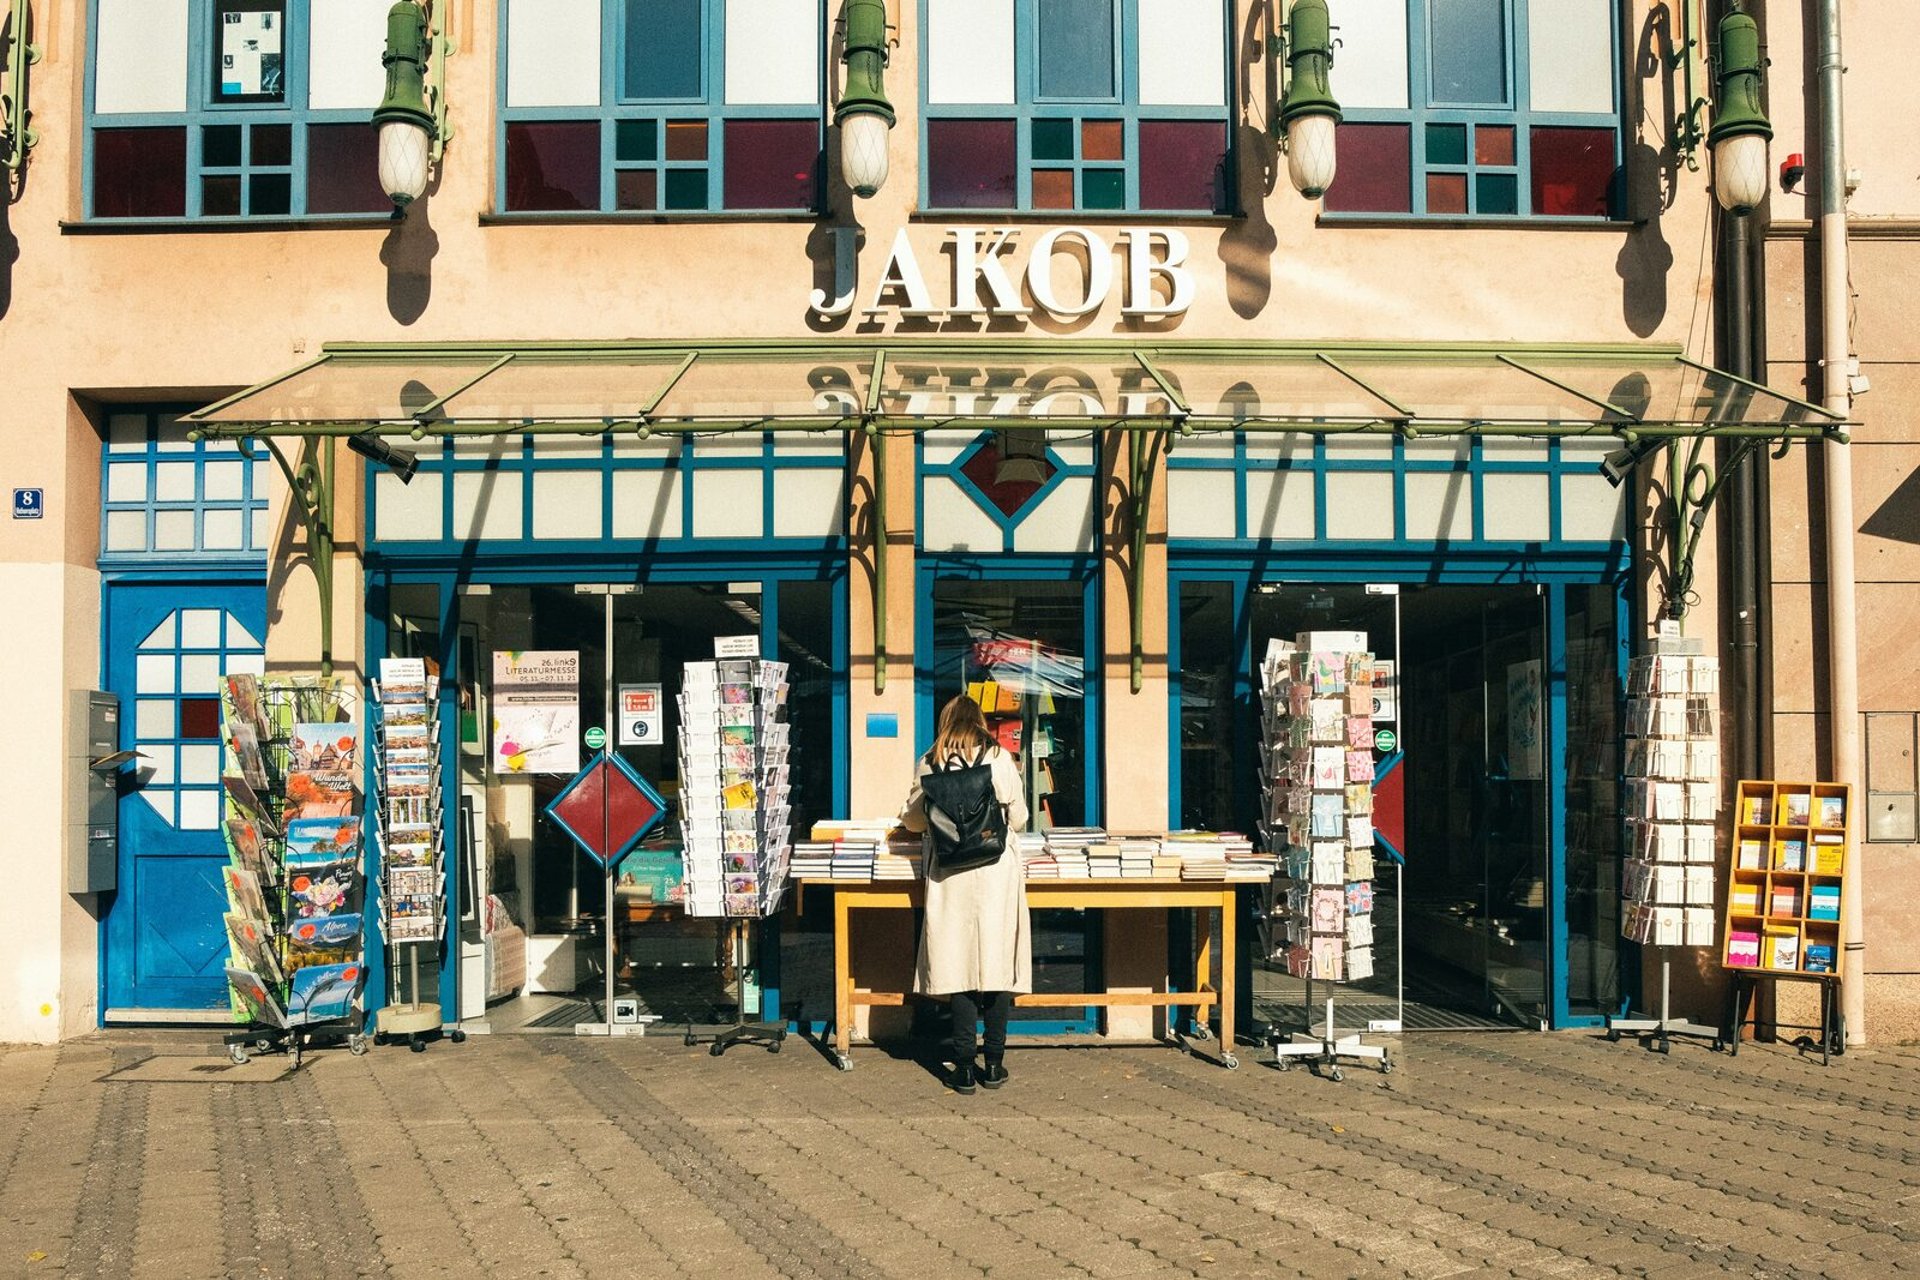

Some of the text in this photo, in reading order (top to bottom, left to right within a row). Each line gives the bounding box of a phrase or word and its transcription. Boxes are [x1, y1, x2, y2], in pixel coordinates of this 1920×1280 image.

[809, 226, 1196, 317] JAKOB
[22, 491, 34, 506] 8
[541, 659, 553, 667] 26.
[505, 666, 577, 675] LITERATURMESSE
[328, 781, 352, 791] Welt
[321, 920, 348, 933] Alpen
